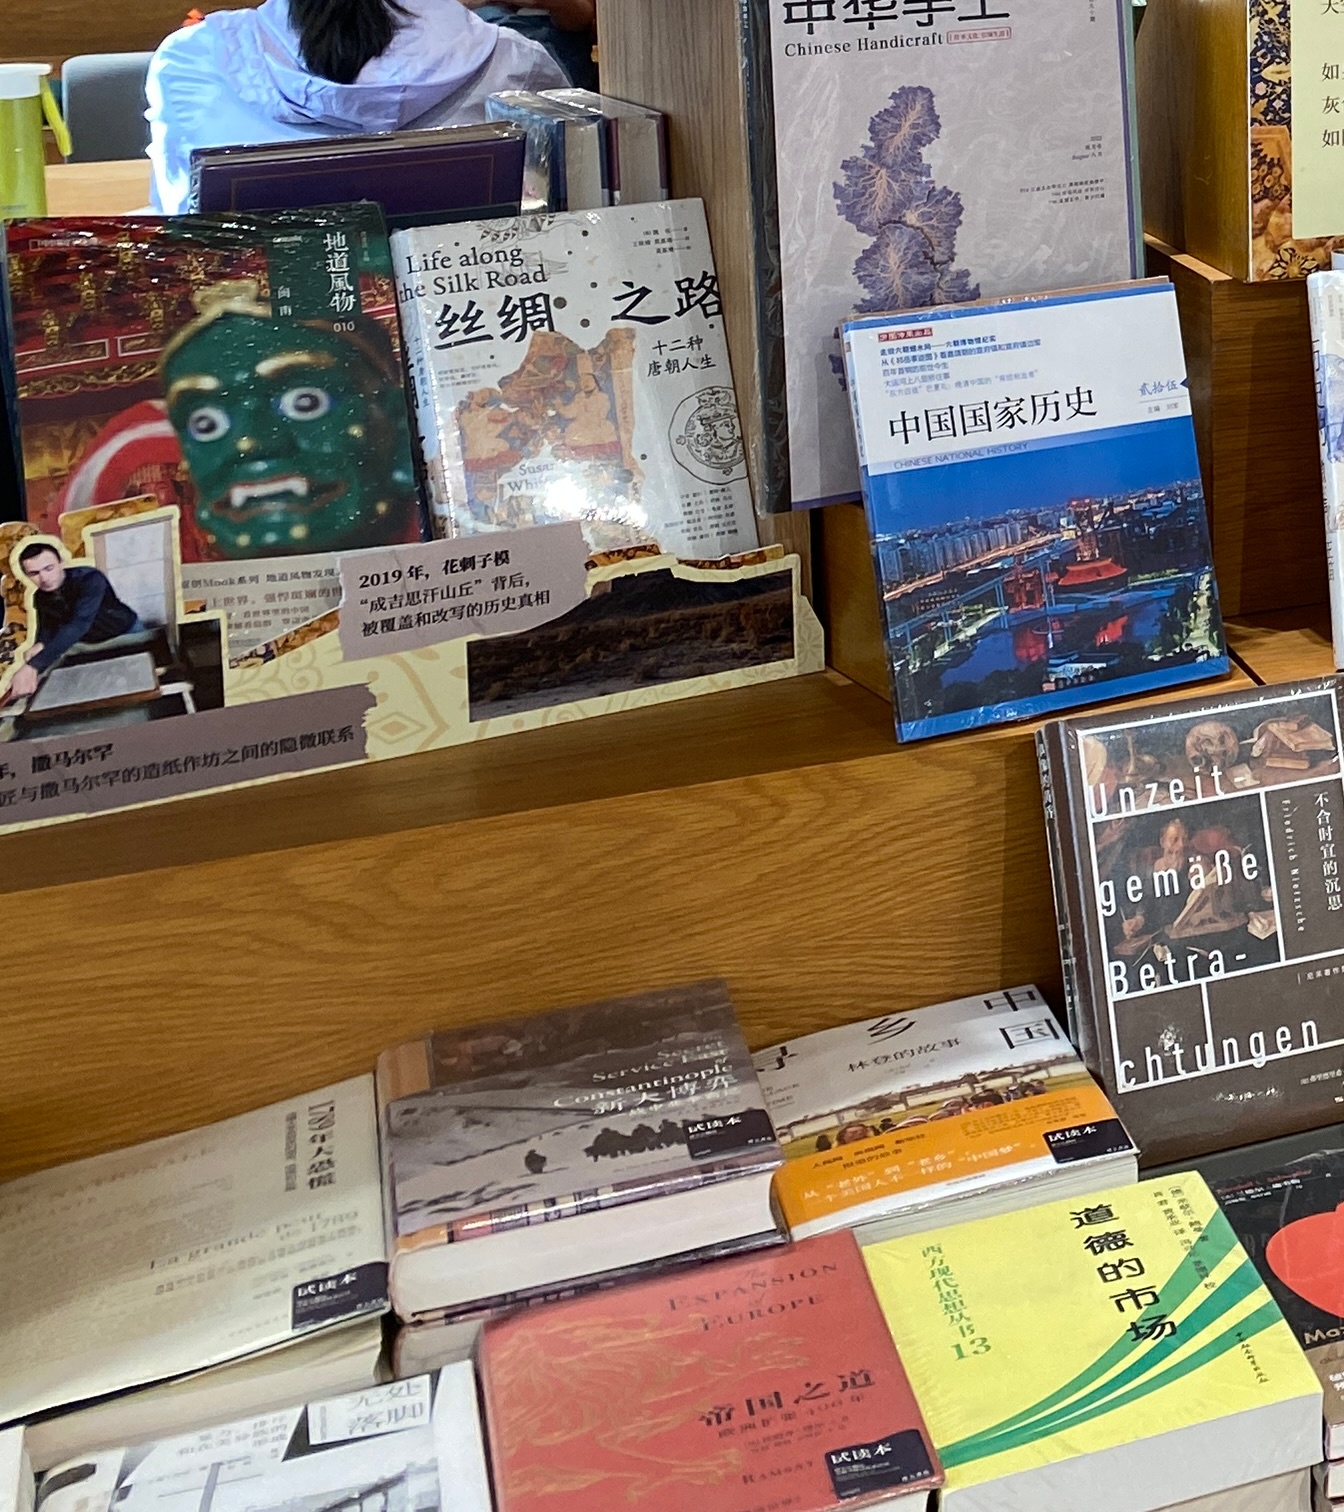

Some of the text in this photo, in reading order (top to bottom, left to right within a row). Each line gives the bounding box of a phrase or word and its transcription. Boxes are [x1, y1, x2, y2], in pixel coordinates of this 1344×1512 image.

[784, 30, 945, 58] Chinese Handicraft
[322, 231, 356, 313] 地道風物
[406, 246, 524, 275] Life along
[398, 264, 549, 303] the Silk Road
[332, 321, 356, 333] 010
[434, 269, 723, 350] 丝绸 之路
[651, 335, 704, 355] 十二种
[646, 354, 717, 378] 唐朝人生
[888, 385, 1098, 446] 中国国家历史
[893, 441, 1029, 470] CHINESE NATIONAL HISTORY
[358, 568, 403, 590] 2019
[360, 590, 551, 638] 被覆盖和改写的历史真相
[1087, 762, 1248, 820] Unzeit-
[1280, 799, 1307, 933] Friedrich Nietzsche
[1313, 791, 1344, 912] 不合时宜的沉思
[1099, 847, 1260, 917] gemäße
[1109, 948, 1248, 997] Betra-
[592, 1059, 676, 1084] Service
[847, 1036, 962, 1074] 林登的故事
[1119, 1017, 1320, 1089] chtungen
[553, 1063, 734, 1108] Constantinople
[592, 1074, 739, 1116] 新大博弈
[687, 1116, 742, 1134] 试读本
[1048, 1125, 1098, 1144] 试读本
[297, 1271, 358, 1298] 试读本
[667, 1262, 839, 1312] EXPANSION
[921, 1241, 976, 1338] 西方现代思想丛书
[1069, 1202, 1178, 1343] 道德的市场
[700, 1292, 823, 1332] EUROPE
[951, 1336, 992, 1361] 13
[699, 1368, 876, 1427] 帝国之道
[830, 1442, 893, 1465] 试读本
